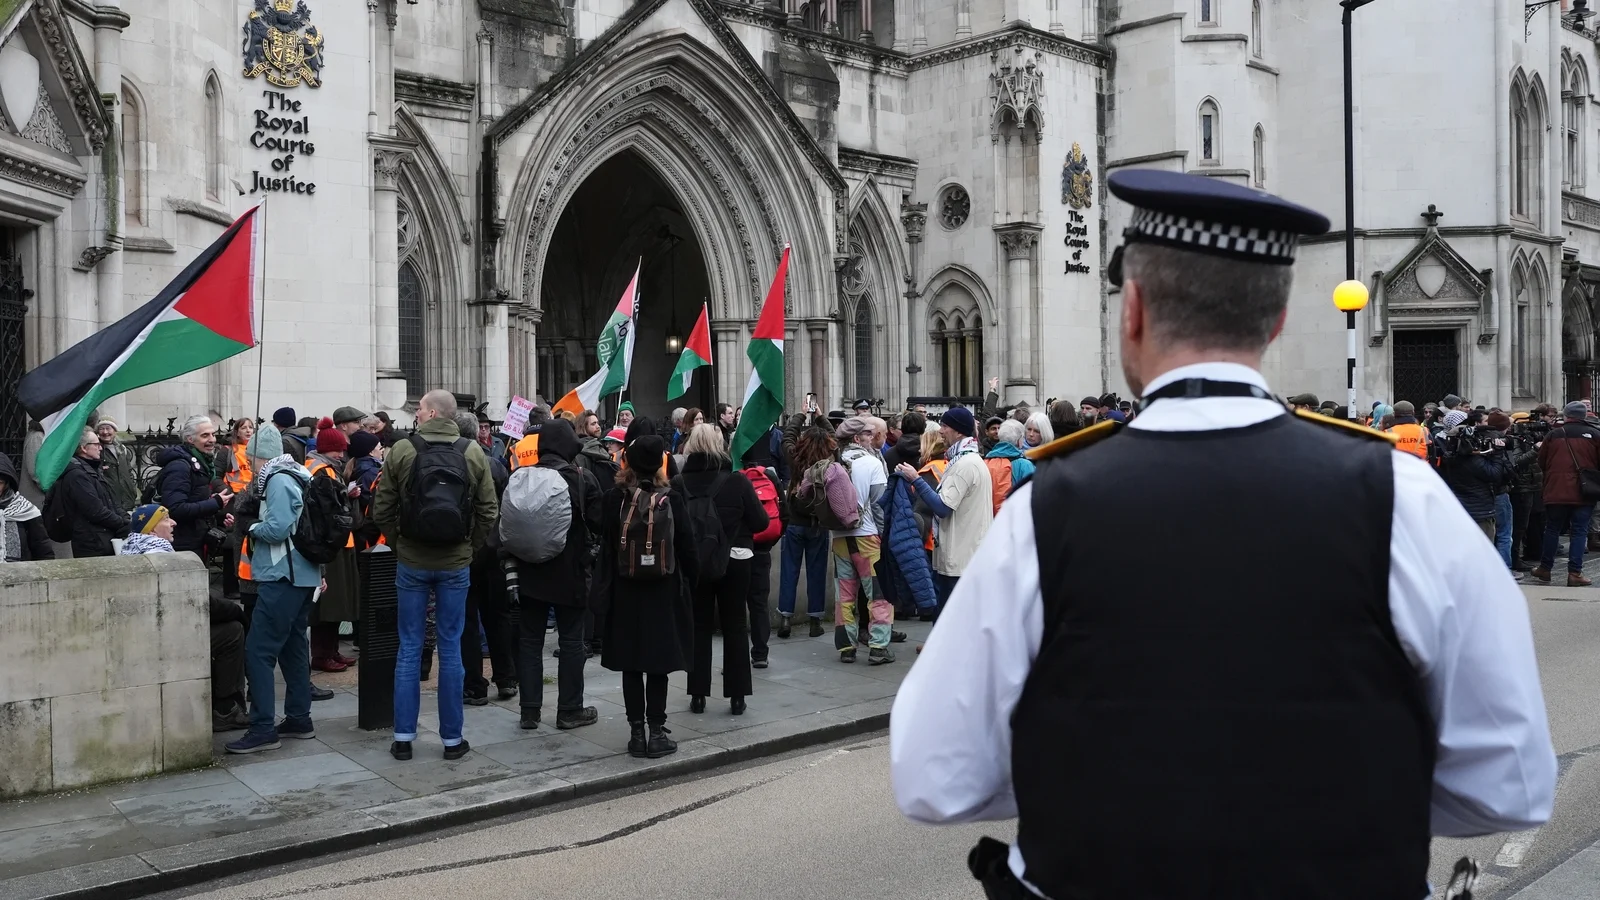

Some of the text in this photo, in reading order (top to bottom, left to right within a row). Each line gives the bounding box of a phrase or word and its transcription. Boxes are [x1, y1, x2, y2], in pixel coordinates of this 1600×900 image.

[263, 90, 302, 113] The
[254, 109, 309, 135] Royal
[250, 131, 315, 156] Courts
[271, 154, 294, 171] of
[250, 170, 316, 196] Justice
[1068, 210, 1084, 223] The
[1066, 222, 1087, 238] Royal
[1064, 235, 1089, 249] Courts
[1072, 249, 1082, 261] of
[1064, 260, 1090, 275] Justice
[517, 400, 532, 410] Stop
[503, 422, 512, 430] US
